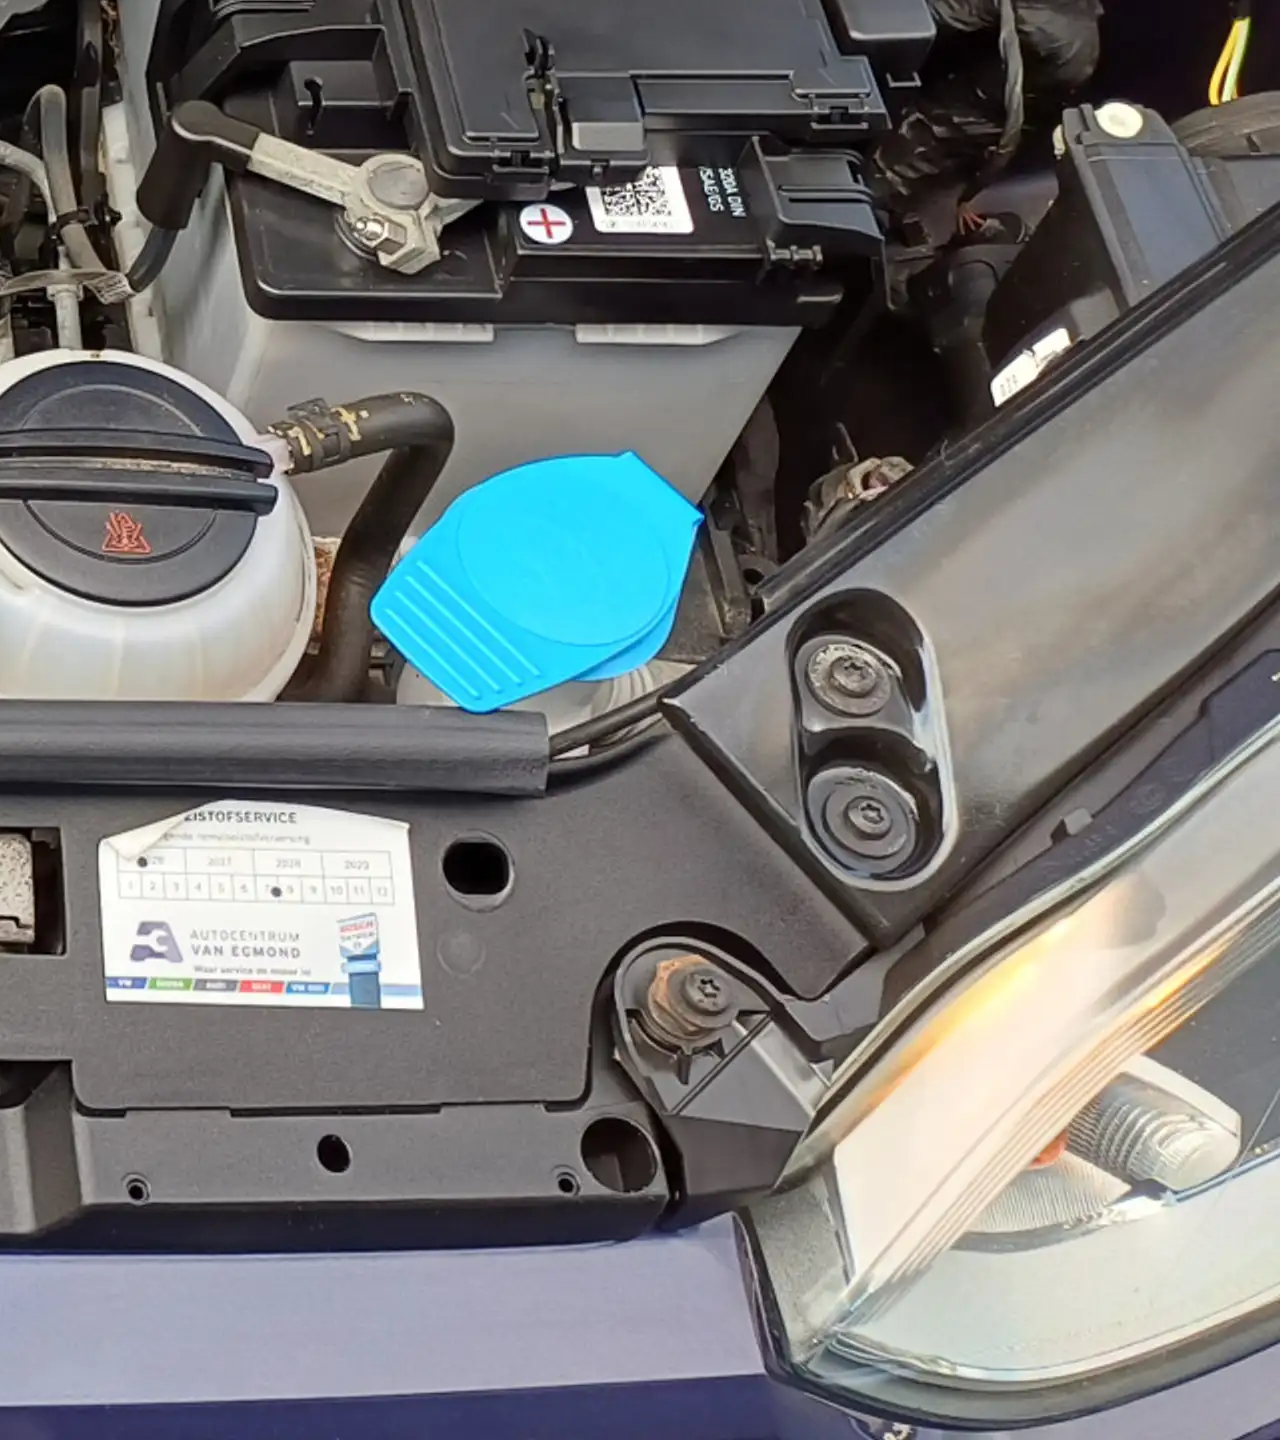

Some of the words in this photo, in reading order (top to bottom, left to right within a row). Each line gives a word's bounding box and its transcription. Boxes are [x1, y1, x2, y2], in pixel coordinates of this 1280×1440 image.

[190, 929, 301, 943] AUTOCENTRUM
[191, 944, 224, 957] VAN
[231, 945, 302, 959] EGMOND
